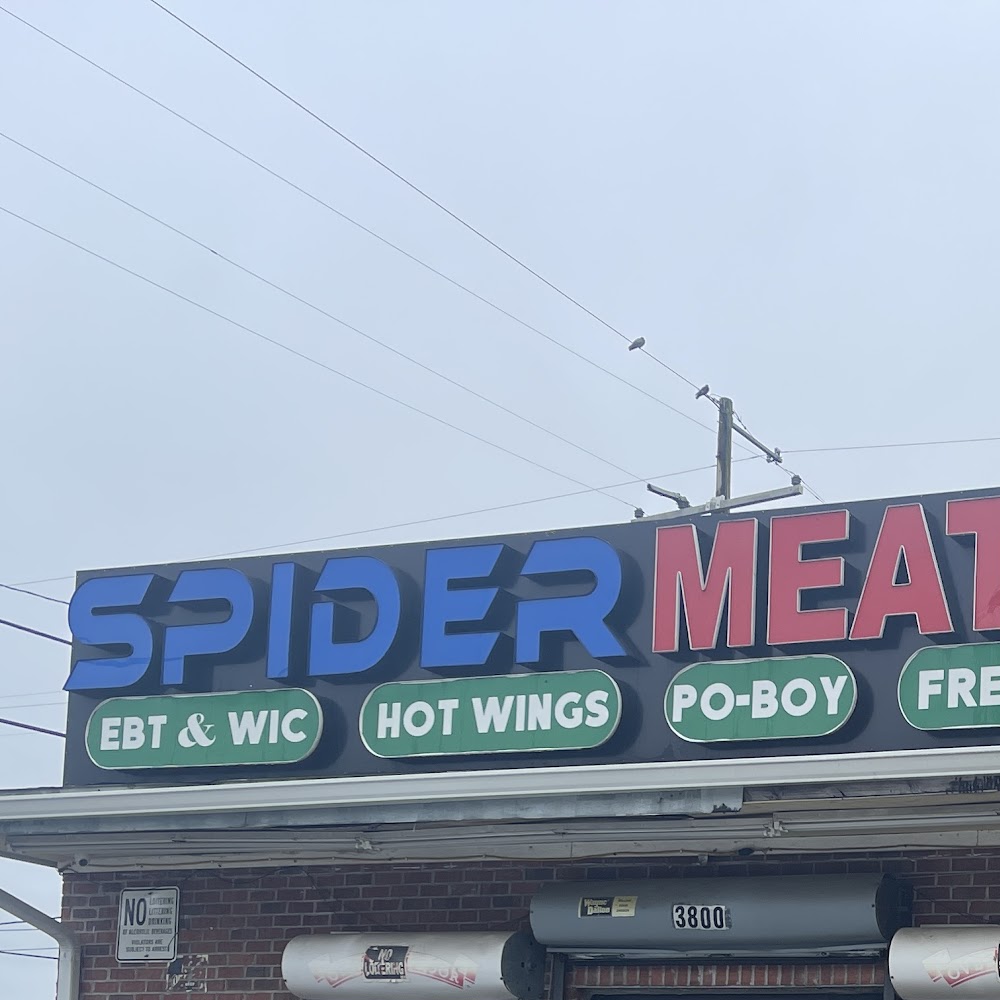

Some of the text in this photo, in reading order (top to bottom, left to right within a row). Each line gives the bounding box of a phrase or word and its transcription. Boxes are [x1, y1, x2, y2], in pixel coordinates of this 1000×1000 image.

[63, 535, 627, 691] SPIDER
[377, 690, 610, 739] HOT WINGS
[672, 675, 848, 723] PO-BOY
[99, 708, 309, 752] EBT & WIC
[124, 898, 147, 926] NO
[675, 905, 725, 929] 3800
[377, 948, 393, 962] NO
